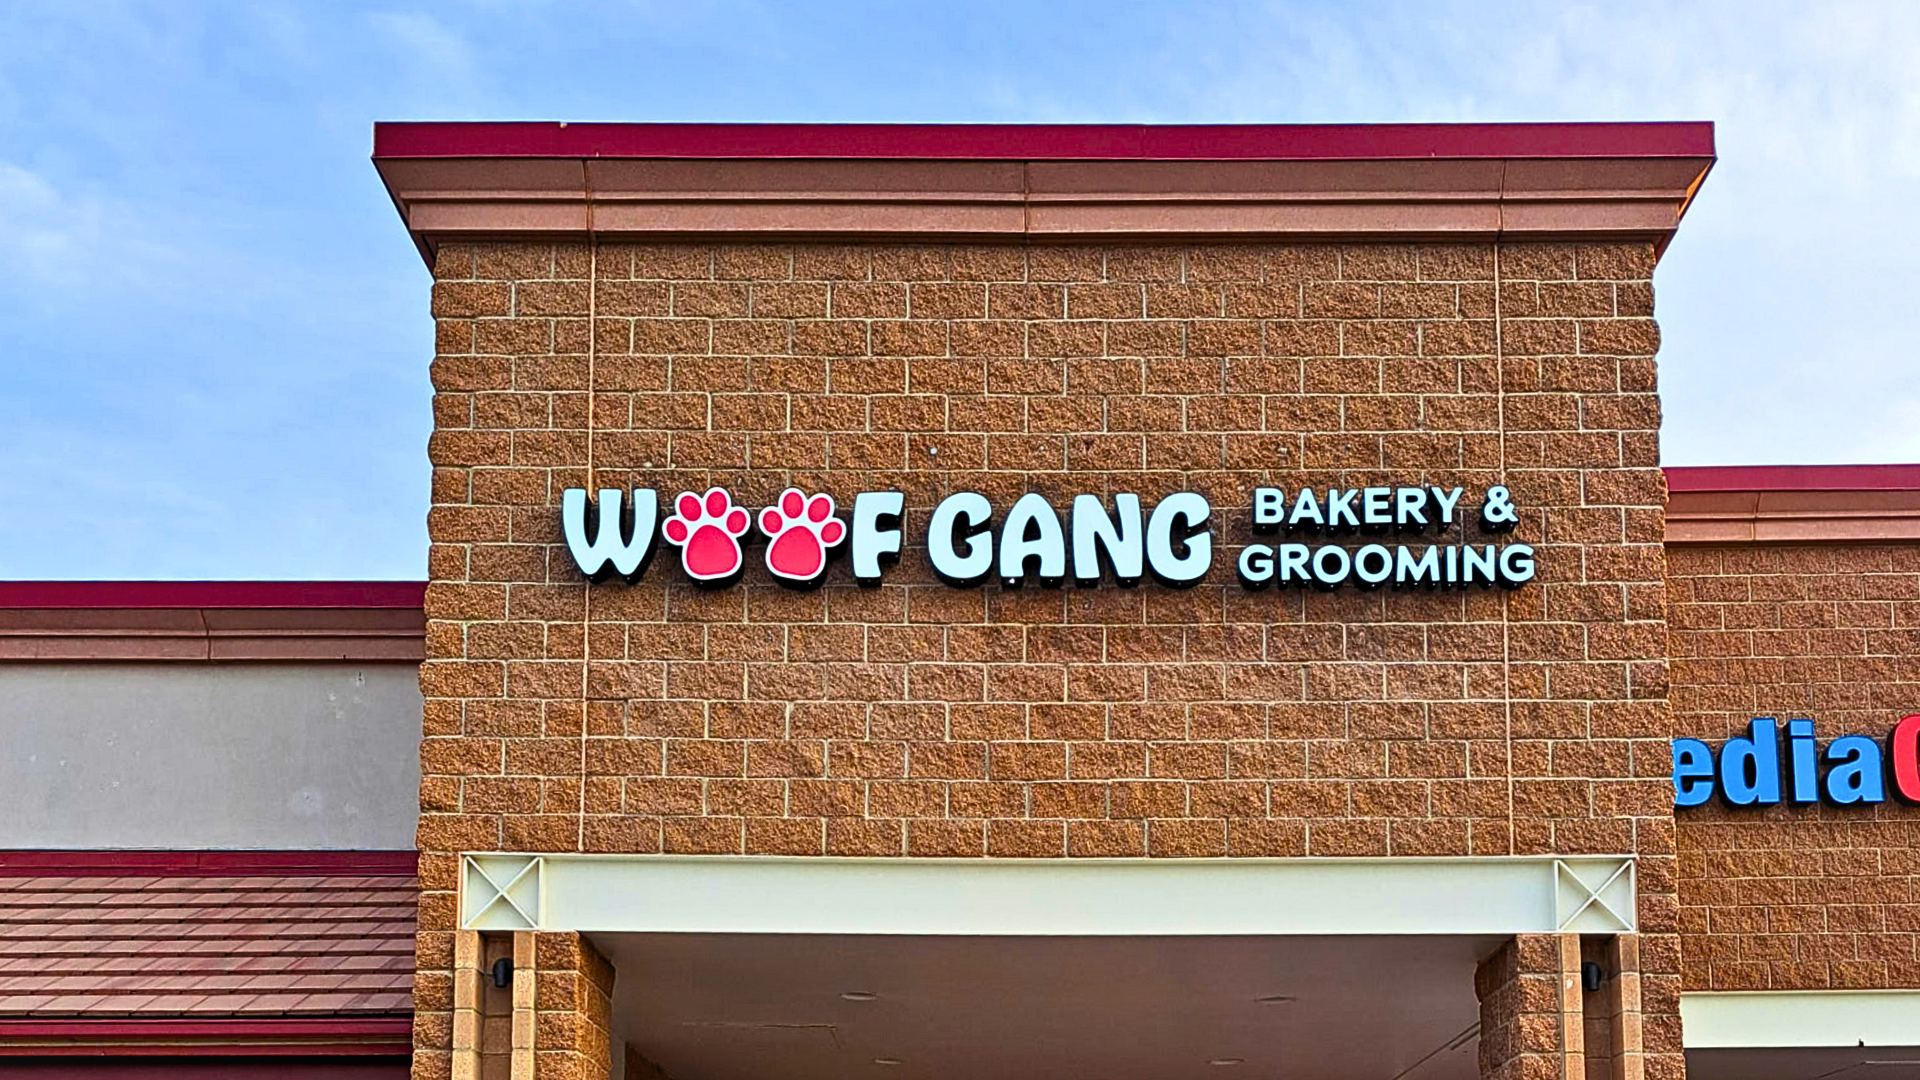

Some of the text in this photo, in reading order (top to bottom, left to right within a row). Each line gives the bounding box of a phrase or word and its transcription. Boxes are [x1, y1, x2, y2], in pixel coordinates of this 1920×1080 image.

[1254, 486, 1519, 526] BAKERY &
[562, 487, 1212, 581] WF GANG
[1238, 544, 1536, 584] GROOMING
